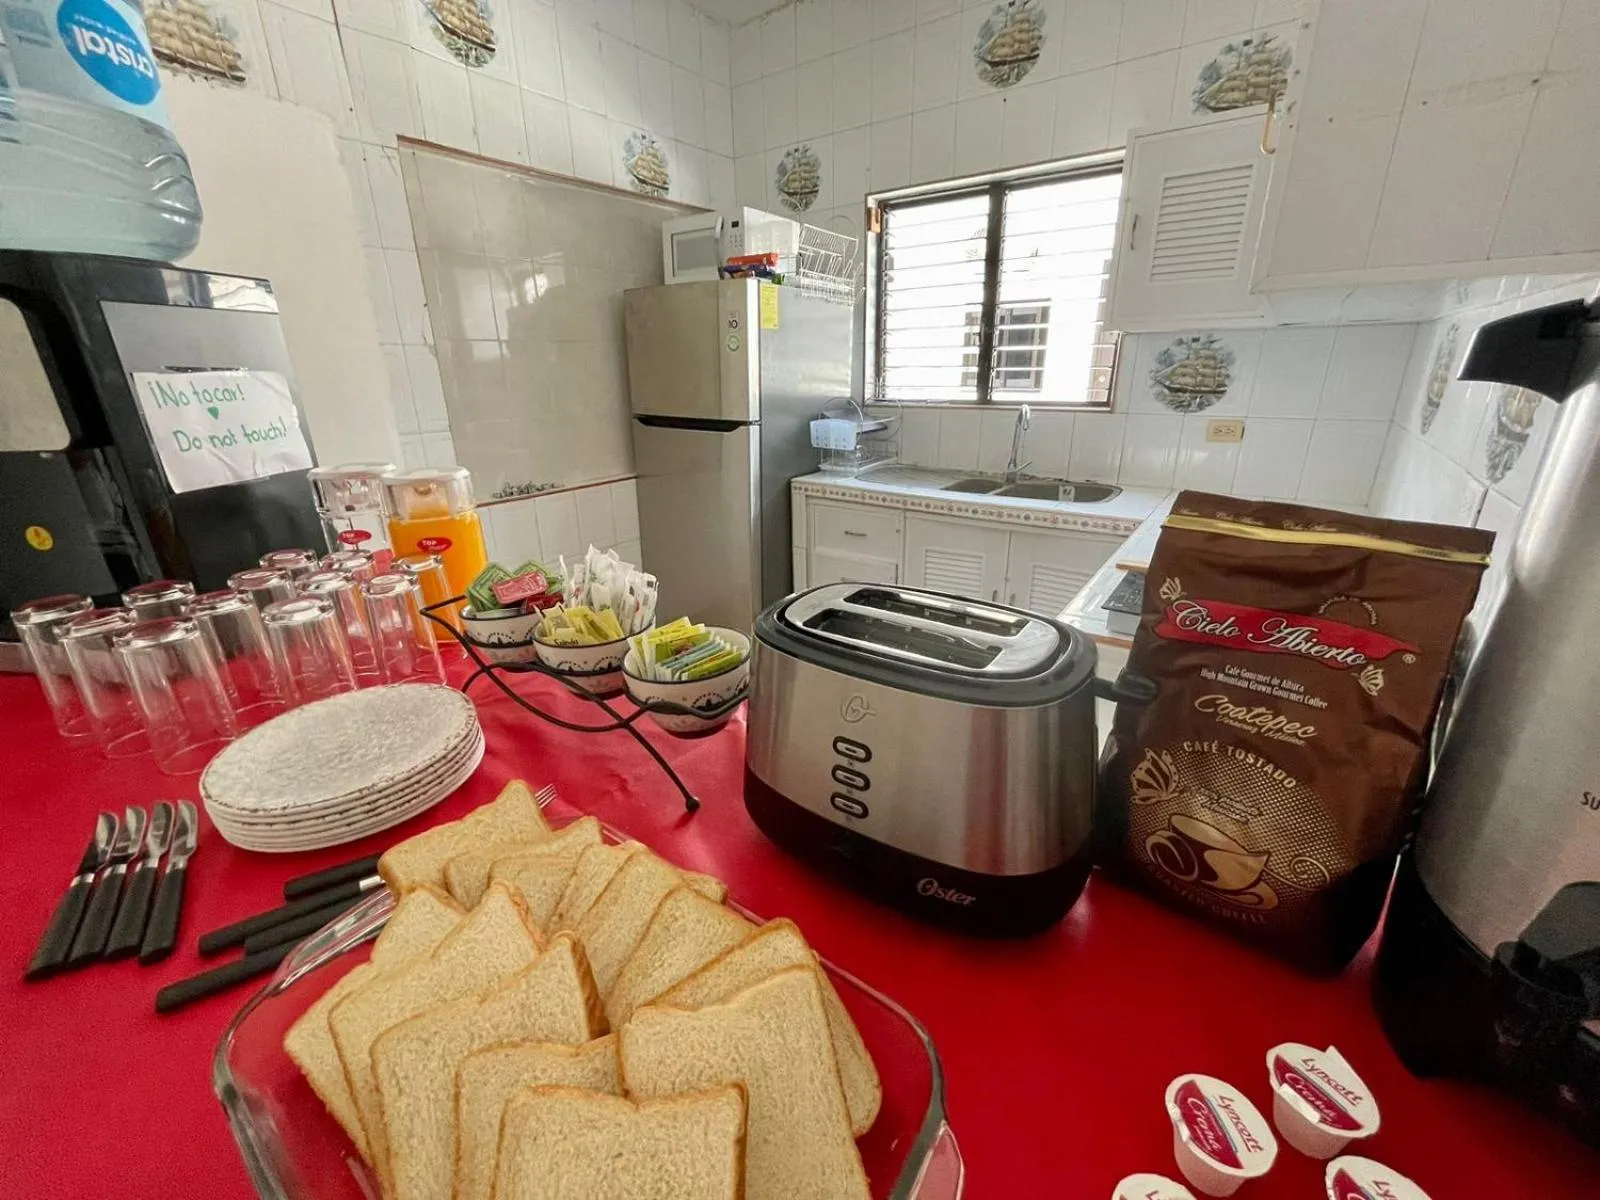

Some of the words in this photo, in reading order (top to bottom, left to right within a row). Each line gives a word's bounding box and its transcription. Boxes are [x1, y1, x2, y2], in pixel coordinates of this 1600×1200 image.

[173, 429, 203, 452] Do
[208, 428, 238, 449] not
[241, 415, 287, 444] touch!
[1172, 600, 1241, 638] Cielo
[1247, 617, 1367, 666] Abierto
[1194, 694, 1318, 738] Coatepec
[1183, 740, 1219, 754] CAFÉ
[1227, 745, 1297, 788] TOSTADO
[917, 877, 976, 906] Oster
[1300, 1057, 1363, 1107] Lyncott
[1216, 1094, 1264, 1153] Lyncott
